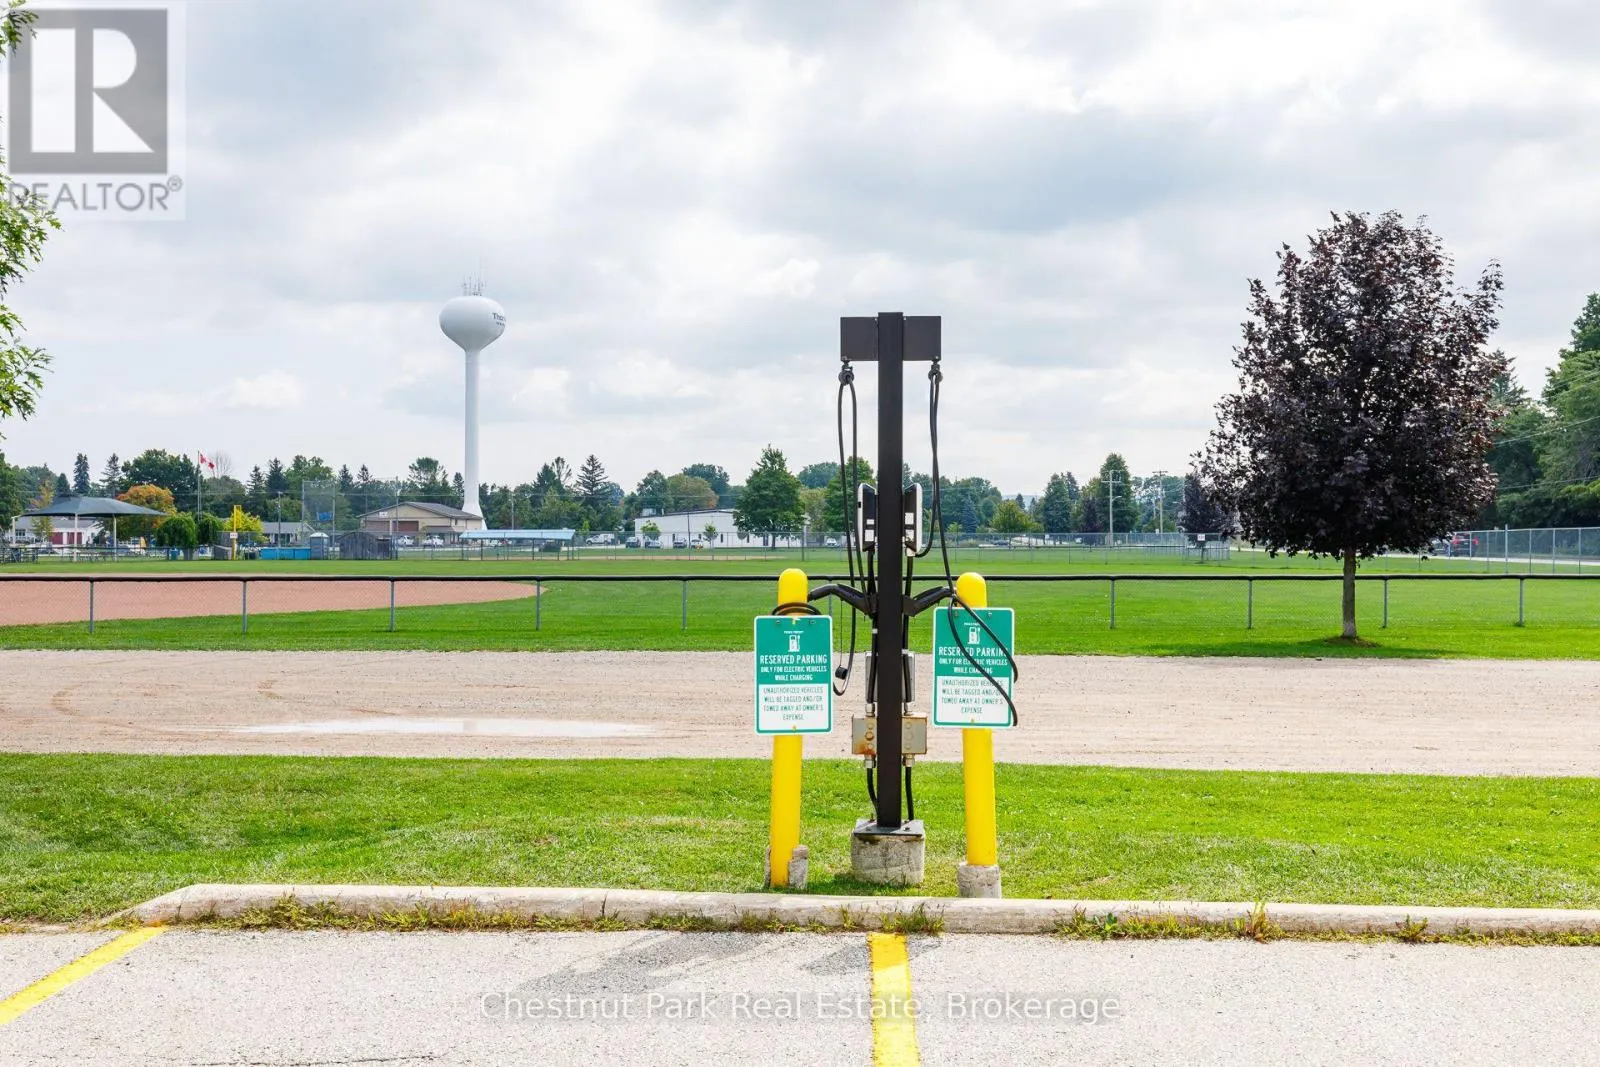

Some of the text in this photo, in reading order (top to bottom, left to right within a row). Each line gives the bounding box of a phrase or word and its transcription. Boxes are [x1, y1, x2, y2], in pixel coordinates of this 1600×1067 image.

[938, 647, 974, 657] RESERED
[760, 654, 827, 664] RESERVED PARKING
